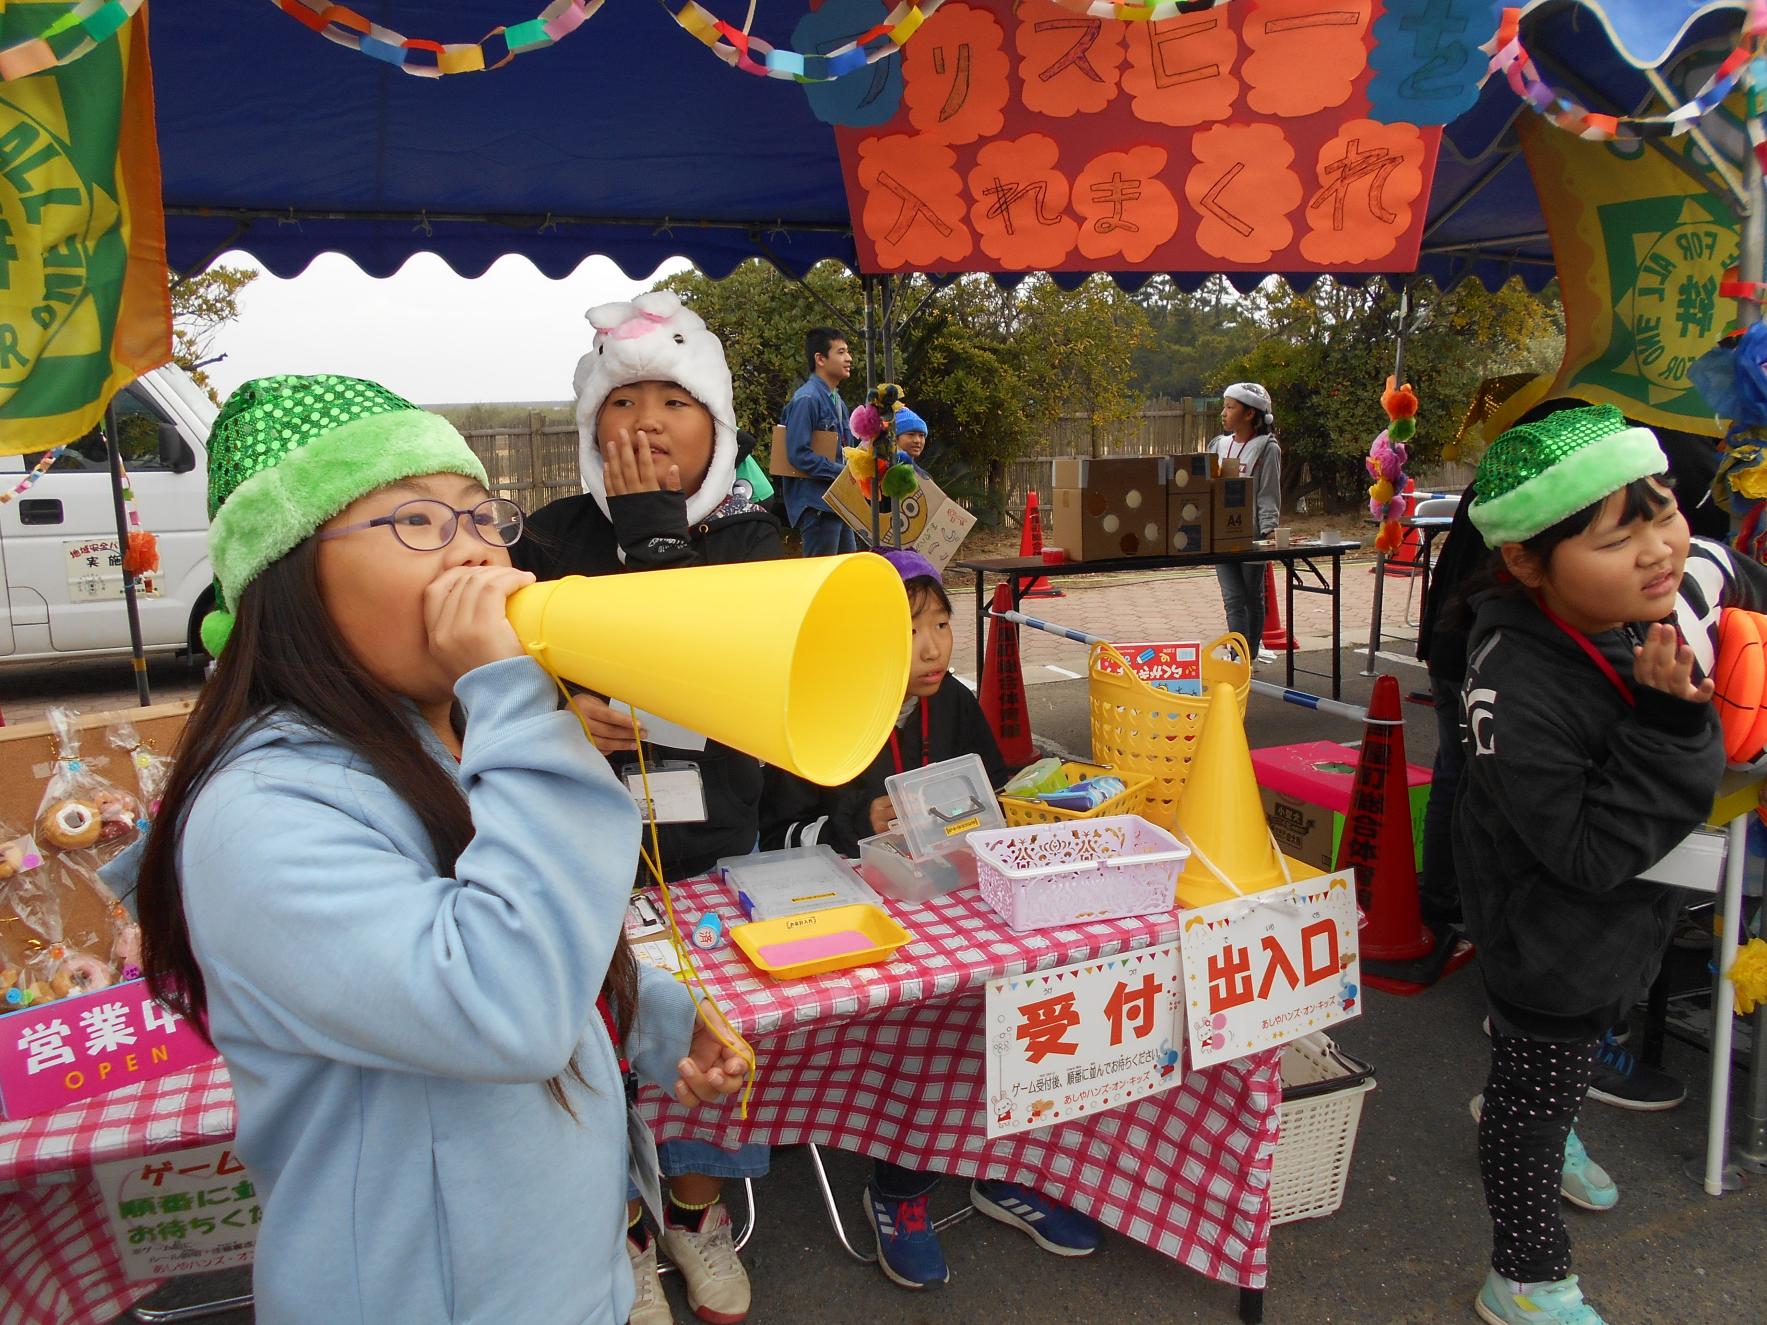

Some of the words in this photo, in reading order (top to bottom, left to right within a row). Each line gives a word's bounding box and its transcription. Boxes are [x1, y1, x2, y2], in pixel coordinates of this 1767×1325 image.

[876, 138, 1404, 247] 入れまくれ
[1227, 513, 1242, 527] A4
[1207, 917, 1341, 1015] 出入口
[1016, 973, 1163, 1065] 受付
[64, 1044, 169, 1090] OPEN
